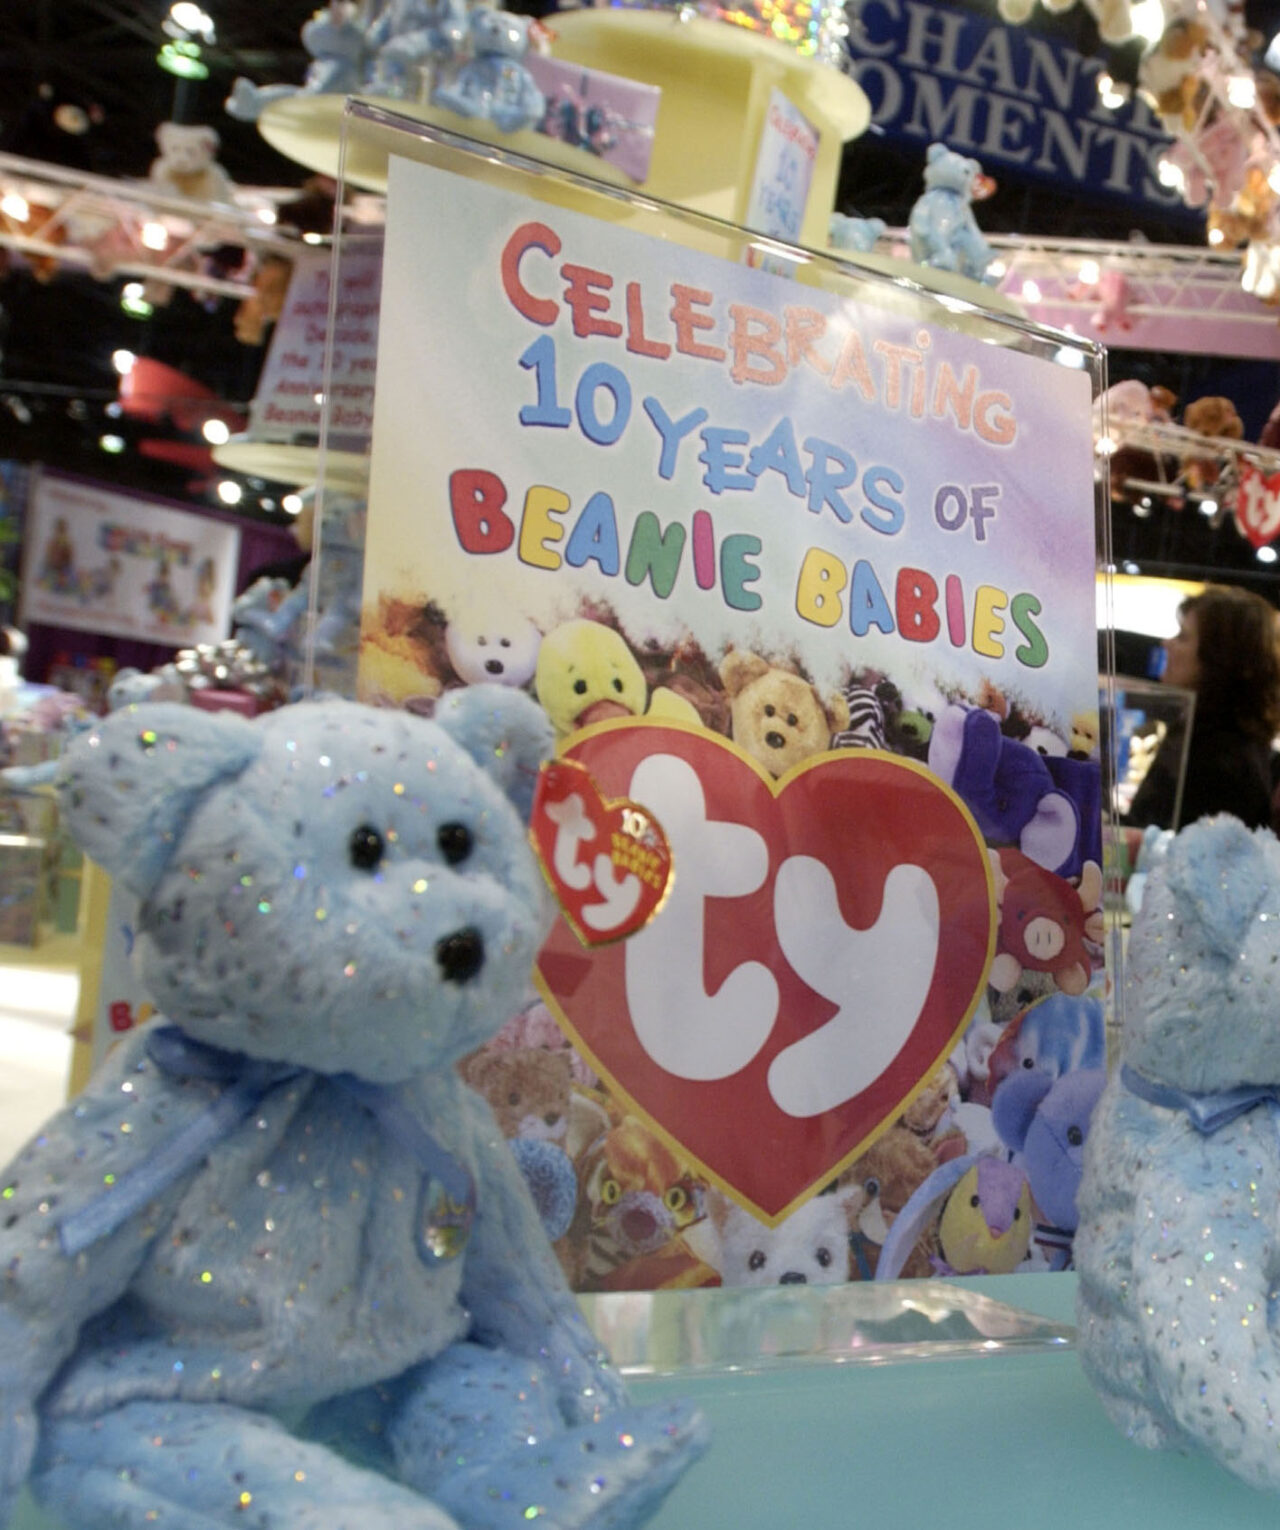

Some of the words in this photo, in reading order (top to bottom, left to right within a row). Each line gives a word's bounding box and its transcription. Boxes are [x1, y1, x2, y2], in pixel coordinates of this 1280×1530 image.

[519, 334, 632, 445] 10
[643, 396, 905, 535] YEARS
[935, 485, 999, 540] OF
[449, 468, 762, 611] BEANIE
[796, 547, 1049, 668] BABIES
[544, 793, 642, 931] ty
[625, 753, 940, 1118] ty
